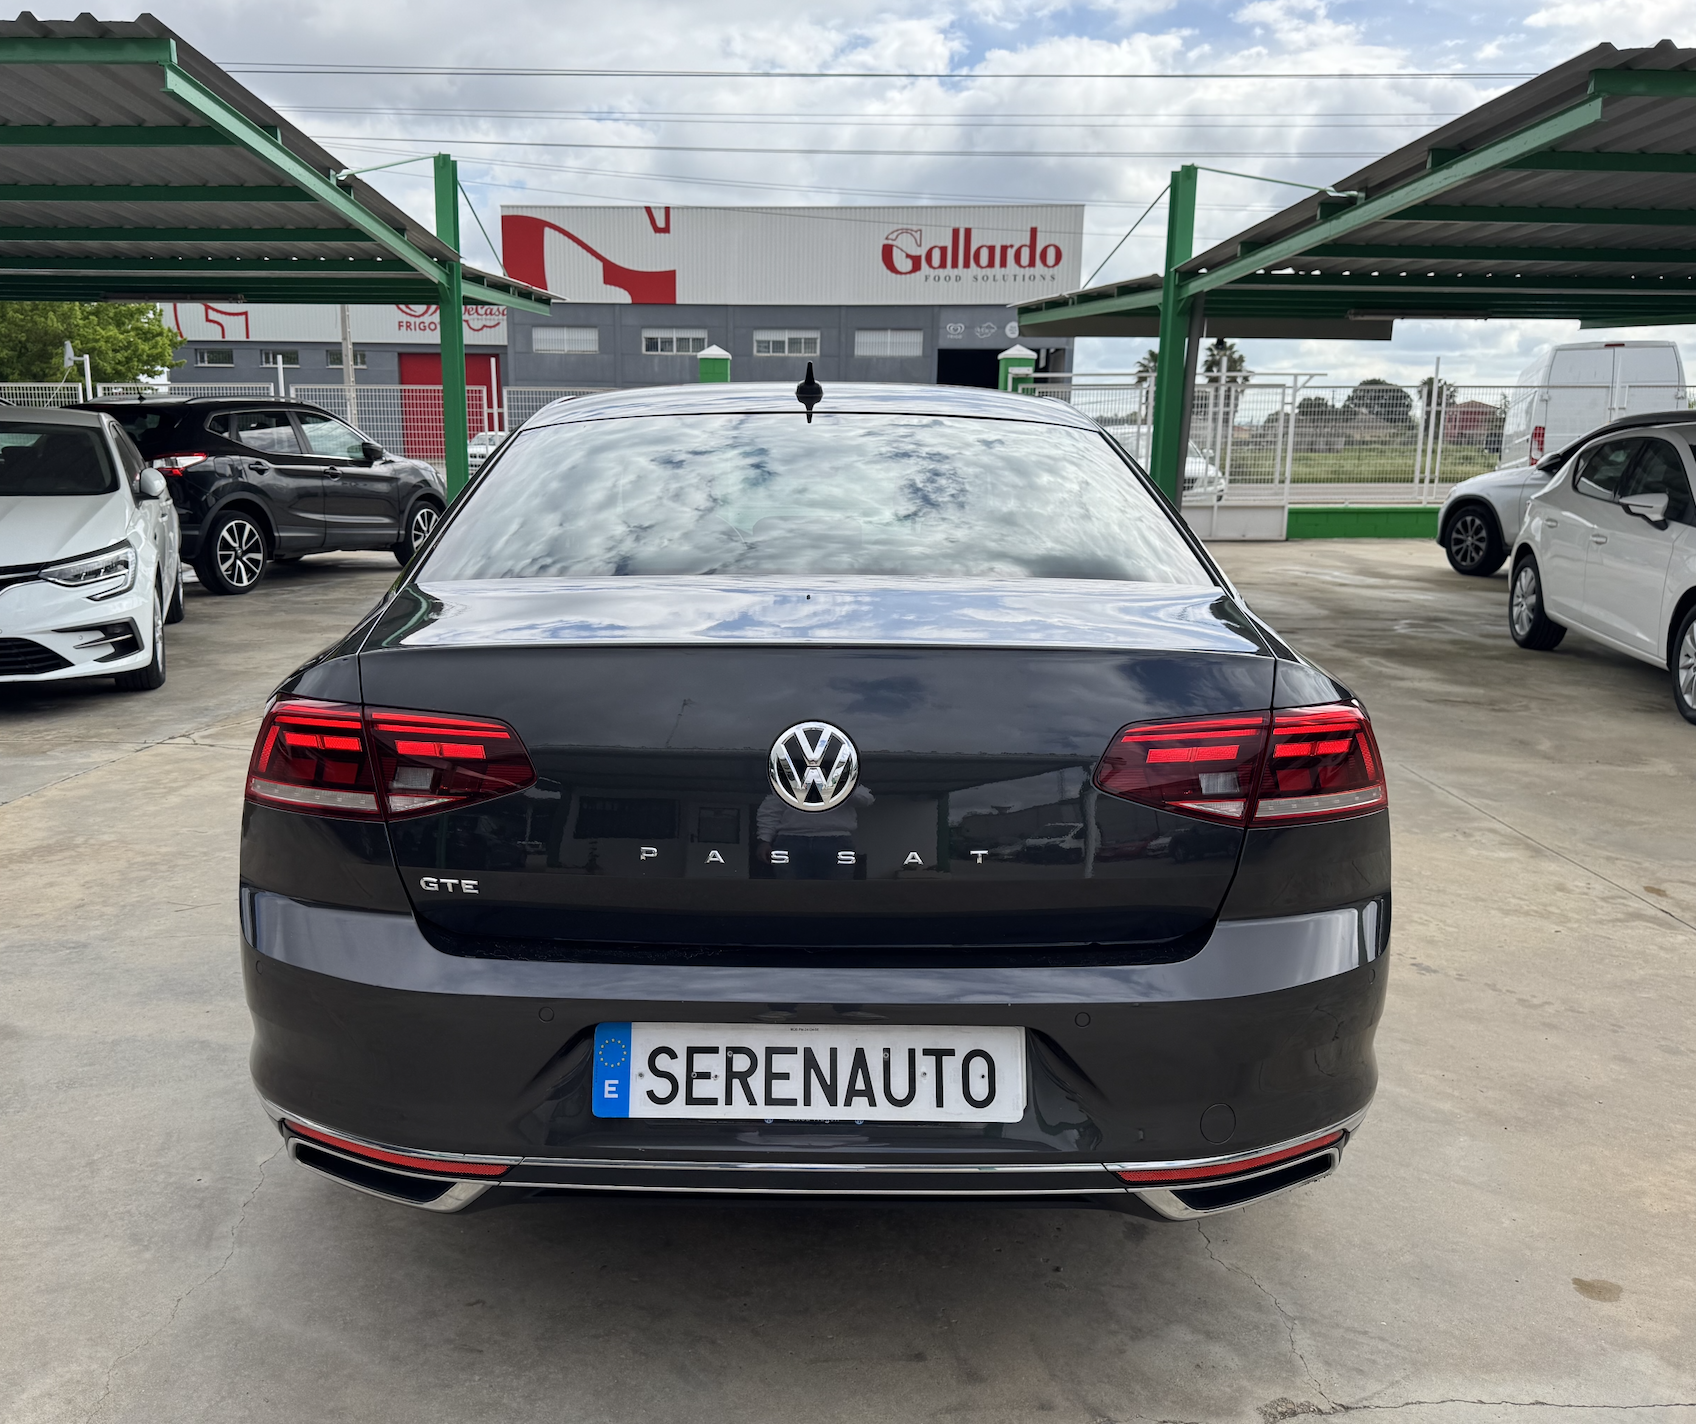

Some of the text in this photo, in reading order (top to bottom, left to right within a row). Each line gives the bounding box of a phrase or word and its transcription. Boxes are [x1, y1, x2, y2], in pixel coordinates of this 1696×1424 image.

[881, 226, 1063, 276] Gallardo
[924, 274, 1056, 283] FOOD SOLUTIONS
[397, 321, 438, 332] FRIGO
[639, 846, 989, 866] PASSAT
[419, 876, 480, 895] GTE
[603, 1079, 619, 1099] E
[645, 1045, 997, 1109] SERENAUTO
